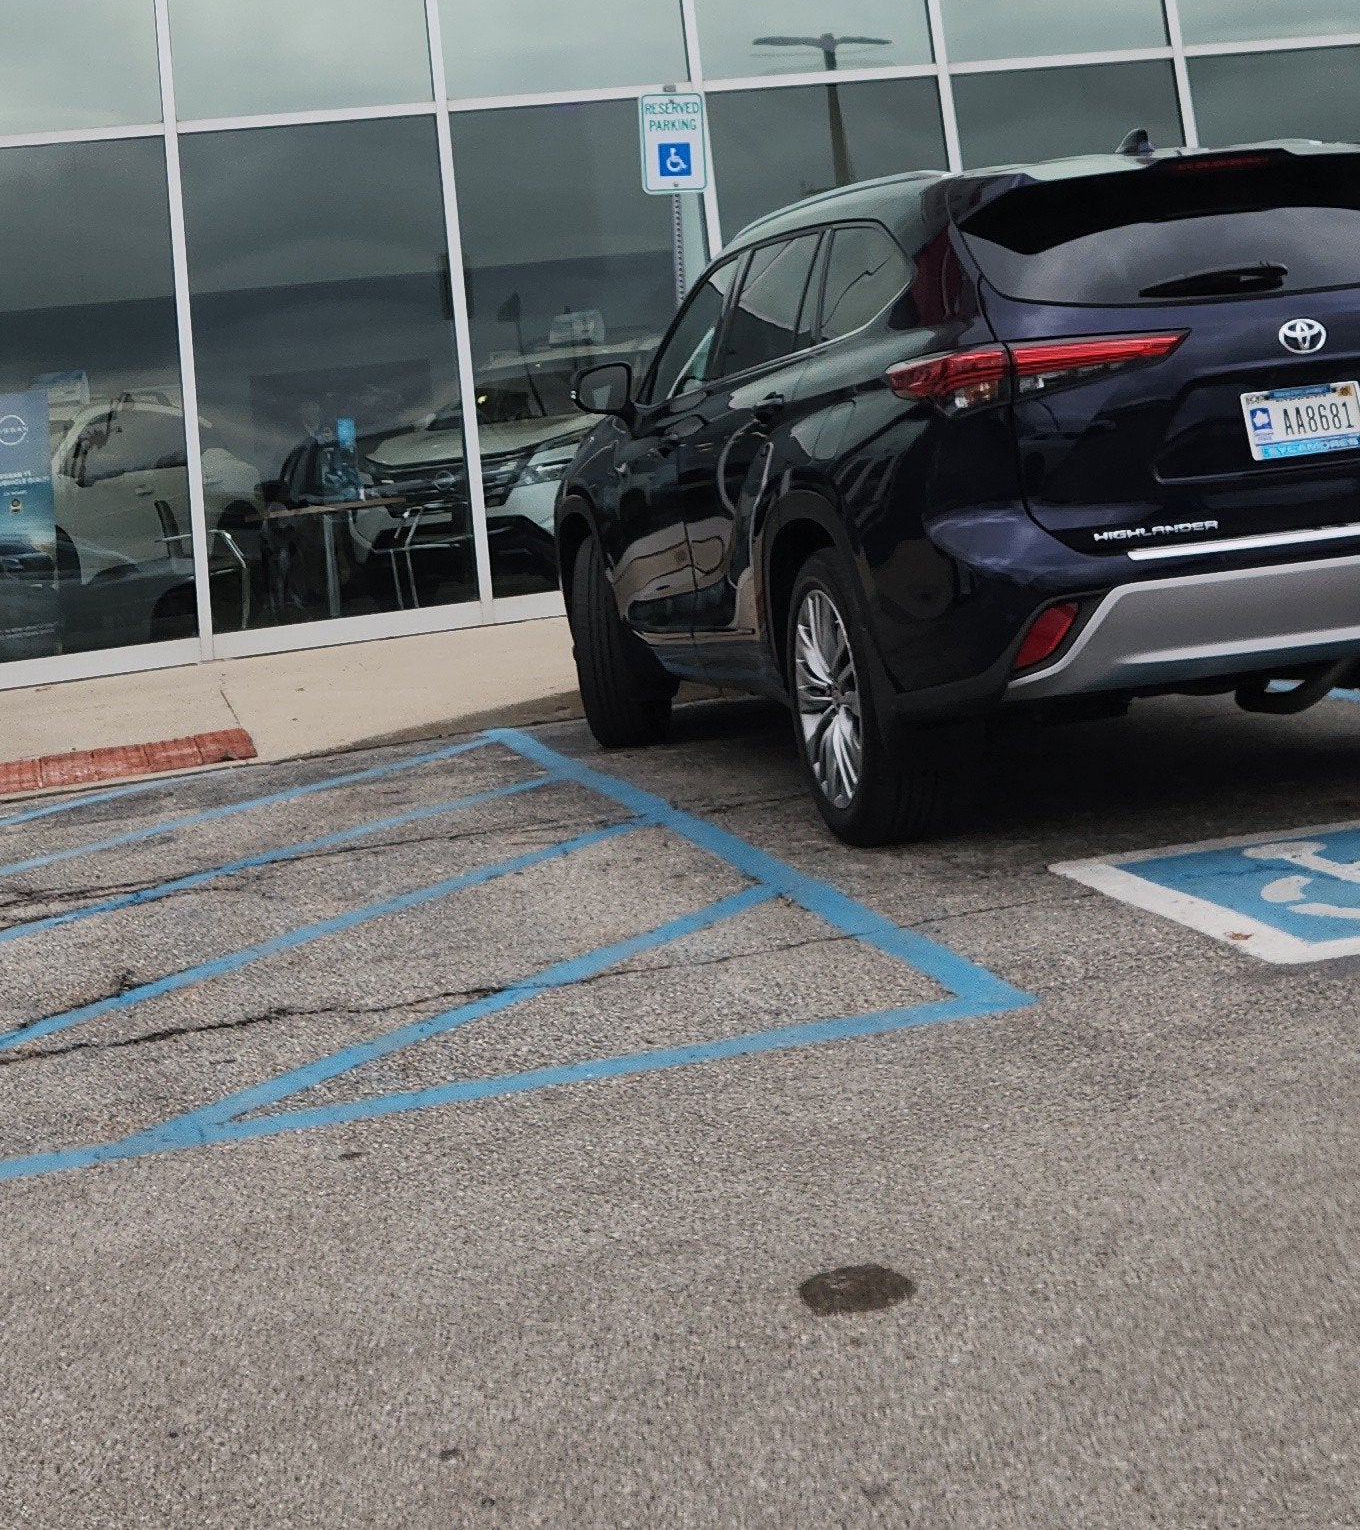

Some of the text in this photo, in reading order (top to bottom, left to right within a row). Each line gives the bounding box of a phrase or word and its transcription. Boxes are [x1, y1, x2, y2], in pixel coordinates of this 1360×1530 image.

[644, 102, 699, 115] RESERVED
[648, 119, 697, 132] PARKING
[1282, 401, 1354, 436] AA8681
[1093, 520, 1219, 541] HIGHLANDER
